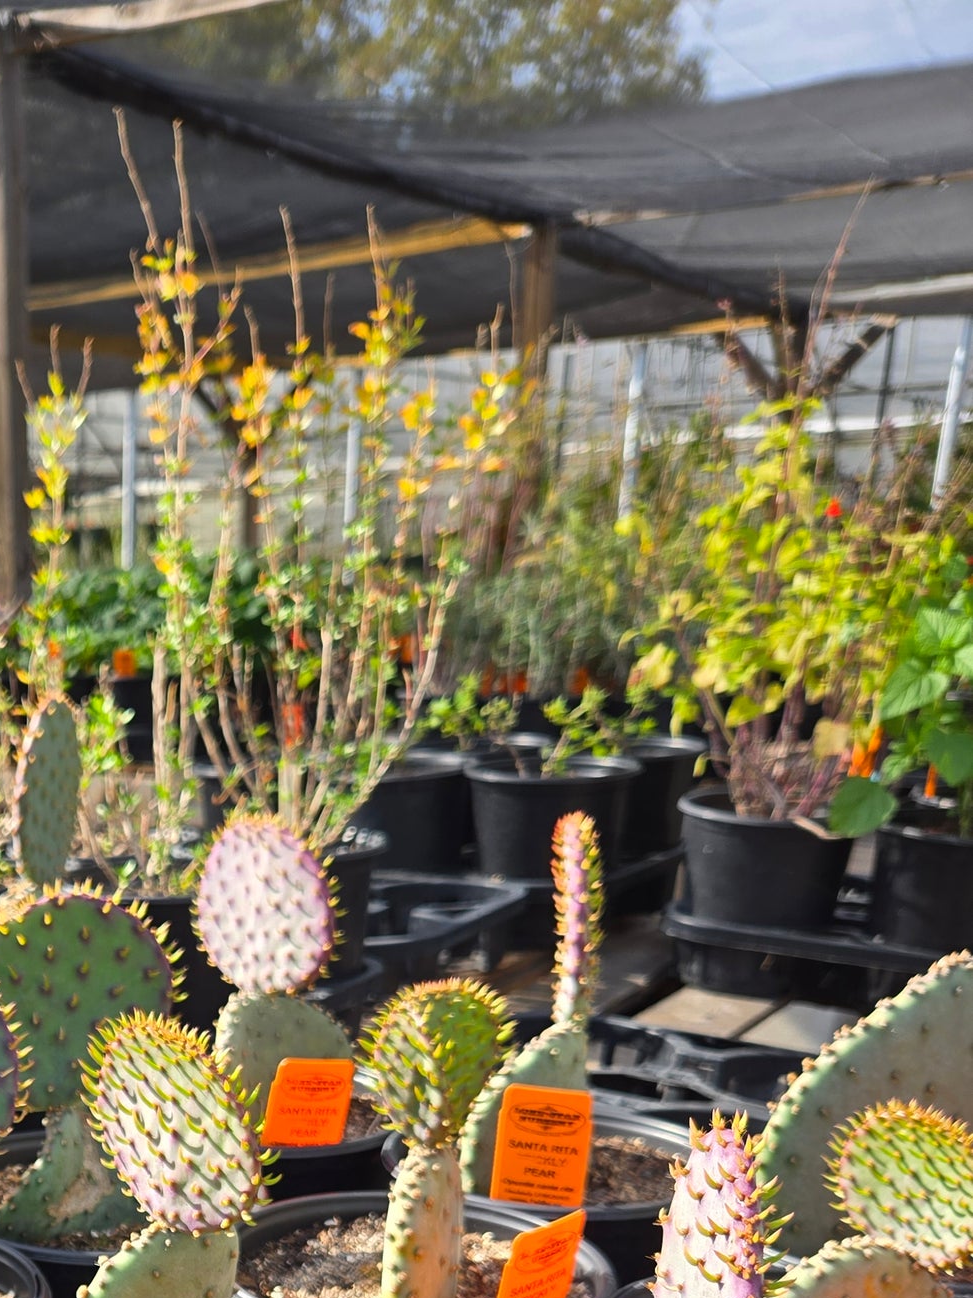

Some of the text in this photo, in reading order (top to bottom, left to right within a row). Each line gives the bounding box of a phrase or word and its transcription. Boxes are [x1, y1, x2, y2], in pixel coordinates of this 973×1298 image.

[508, 1139, 579, 1156] SANTA RITA
[523, 1167, 556, 1179] PEAR
